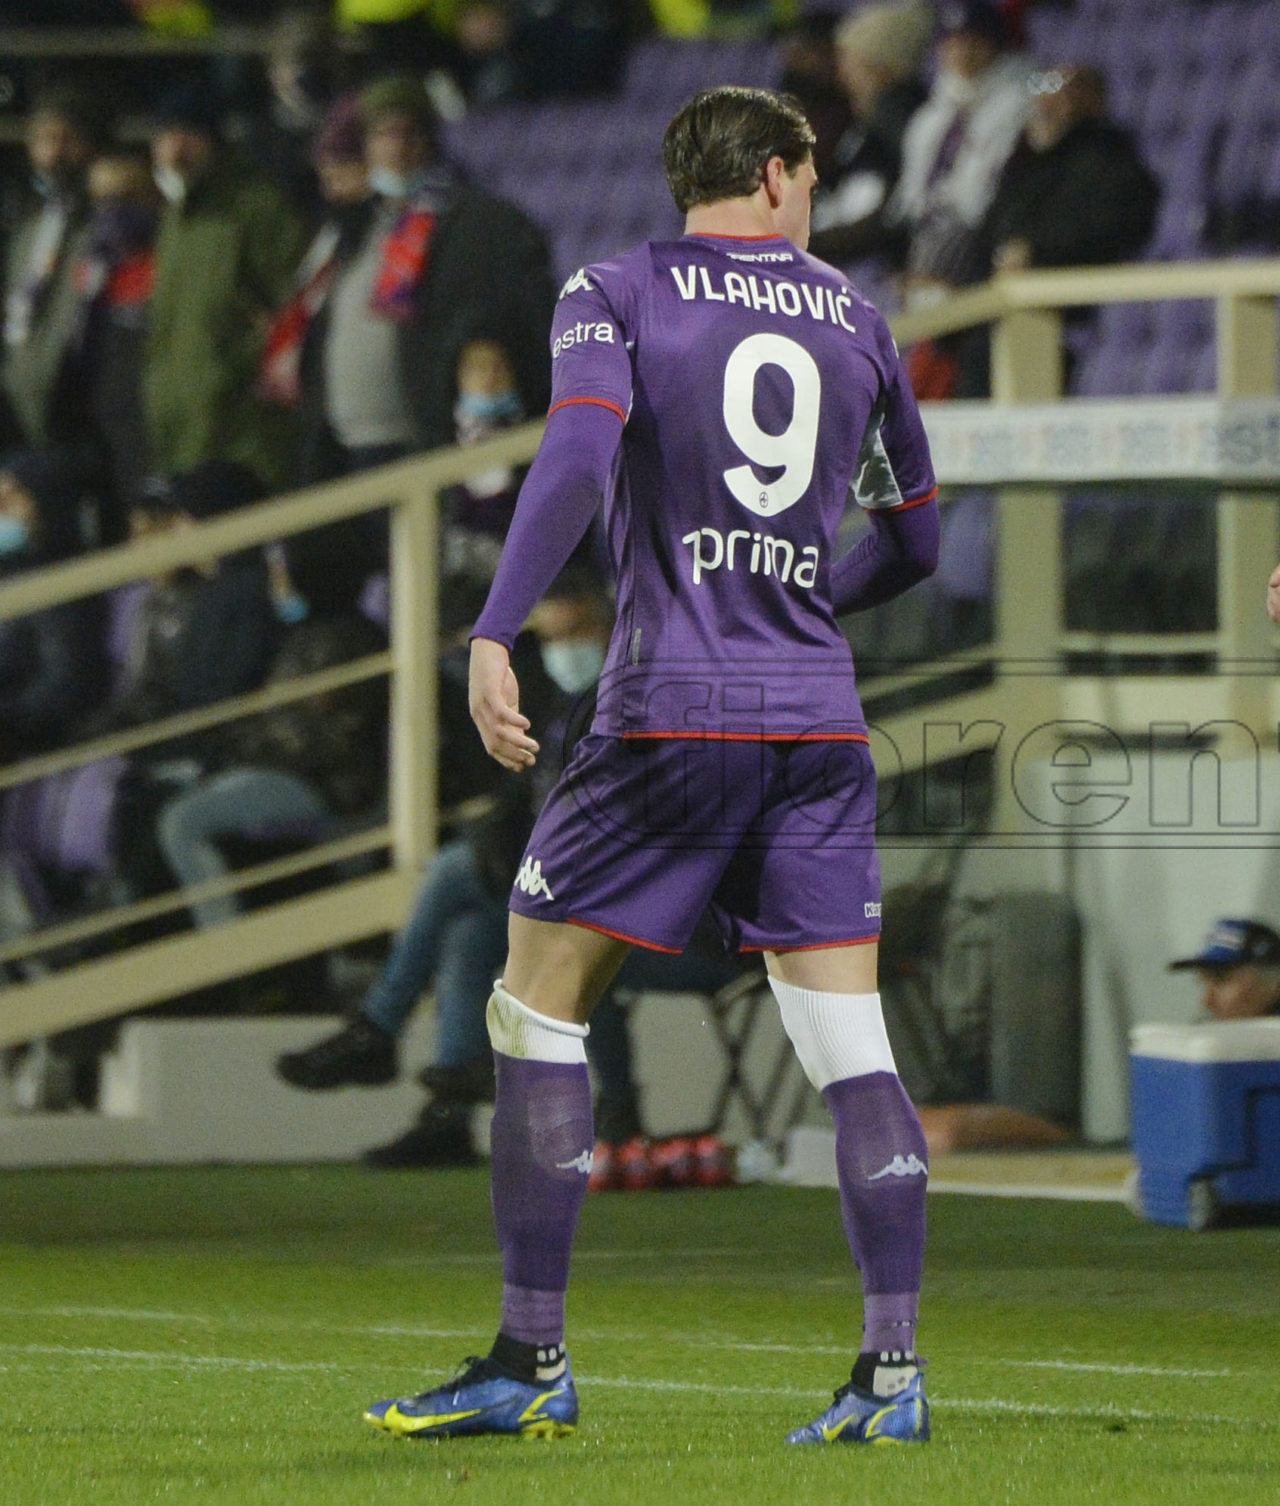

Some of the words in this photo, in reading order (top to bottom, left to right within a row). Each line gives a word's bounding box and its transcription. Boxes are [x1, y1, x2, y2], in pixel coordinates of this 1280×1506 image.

[671, 265, 856, 334] VLAHOVIĆ
[552, 321, 615, 358] estra
[723, 332, 821, 517] 9
[682, 527, 819, 588] prima
